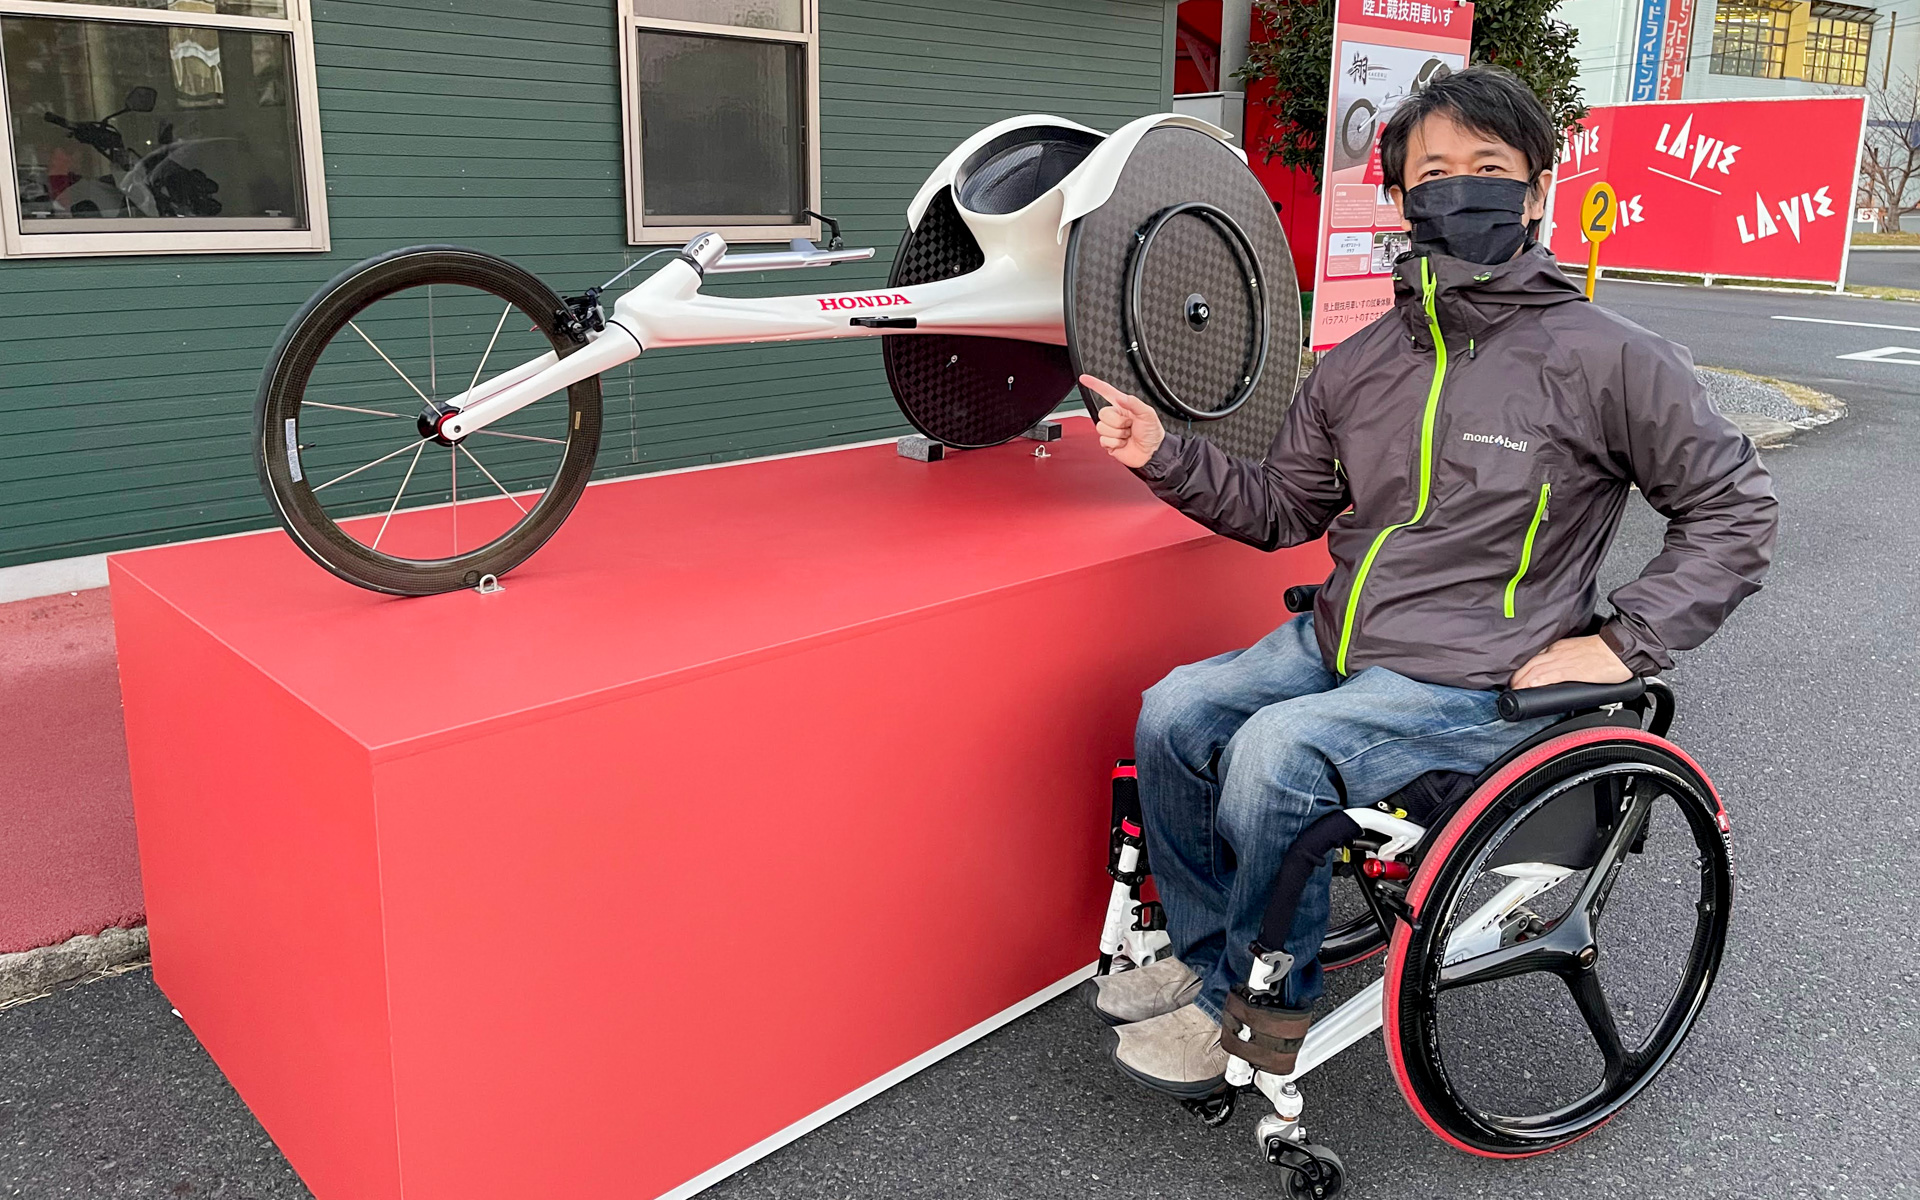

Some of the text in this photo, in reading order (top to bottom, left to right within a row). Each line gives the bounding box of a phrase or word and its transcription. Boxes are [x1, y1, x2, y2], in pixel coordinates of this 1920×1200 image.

[1362, 0, 1454, 27] 陸上競技用車いす
[1636, 0, 1661, 100] ドライビング
[1589, 190, 1609, 231] 2
[817, 294, 912, 311] HONDA
